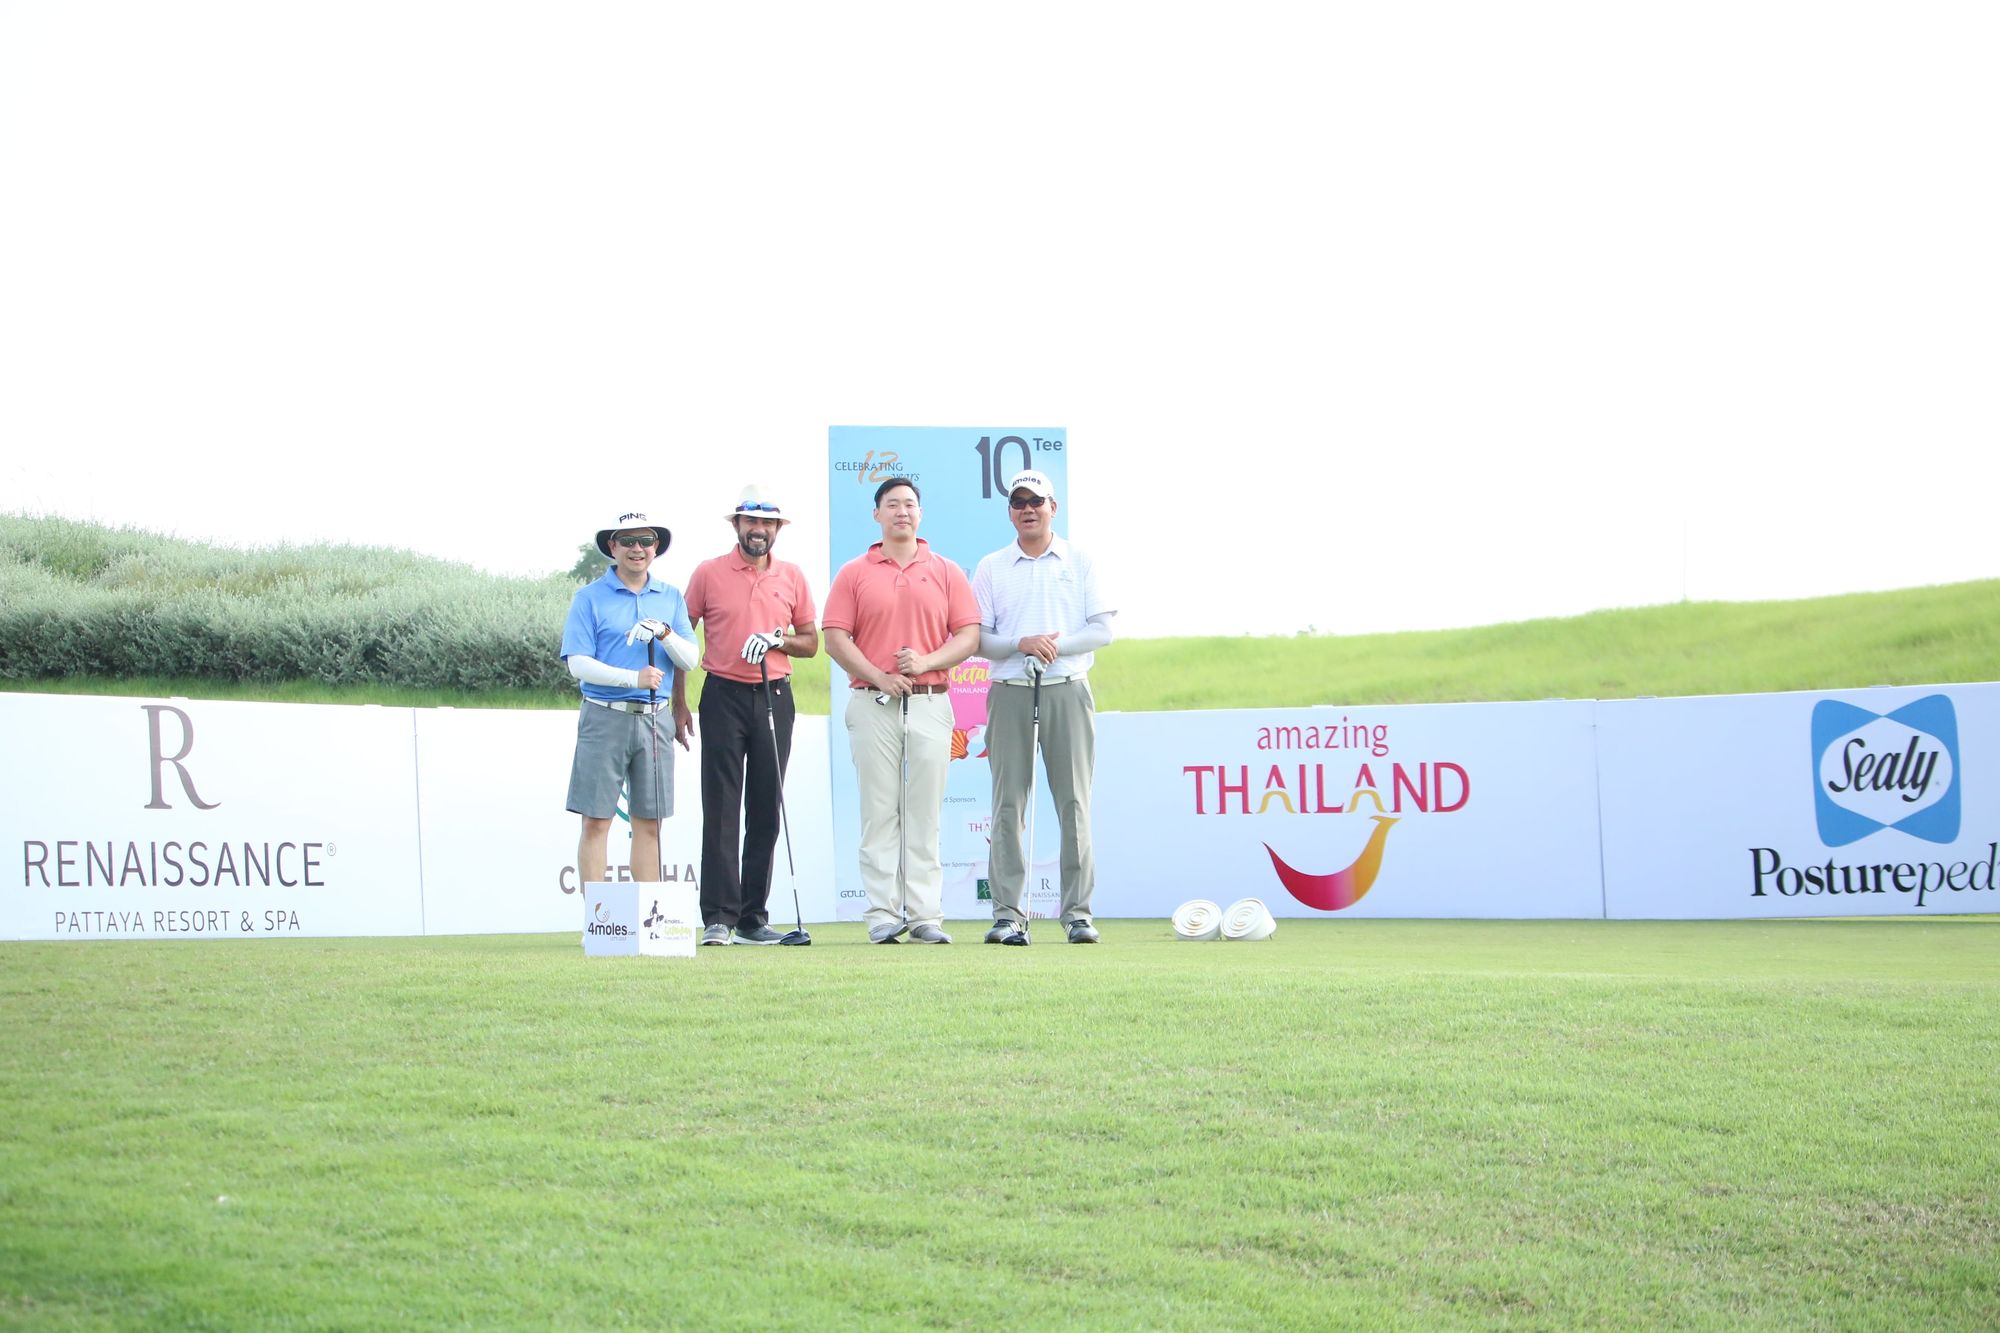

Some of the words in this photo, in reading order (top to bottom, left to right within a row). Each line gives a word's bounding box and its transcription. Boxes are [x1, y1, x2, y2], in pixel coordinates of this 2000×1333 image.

[834, 461, 904, 472] CELEBRATING
[975, 435, 1031, 498] 10
[1033, 438, 1063, 452] Tee
[619, 513, 647, 524] PING
[951, 665, 991, 685] Geta
[953, 687, 989, 695] THAILAND
[140, 704, 222, 811] R
[1256, 715, 1390, 758] amazing
[1182, 761, 1472, 816] THAILAND
[1828, 735, 1940, 803] Sealy
[1747, 841, 2000, 908] Postureped
[55, 910, 146, 933] PATTAYA
[154, 910, 231, 933] RESORT
[240, 910, 255, 933] &
[263, 910, 301, 932] SPA
